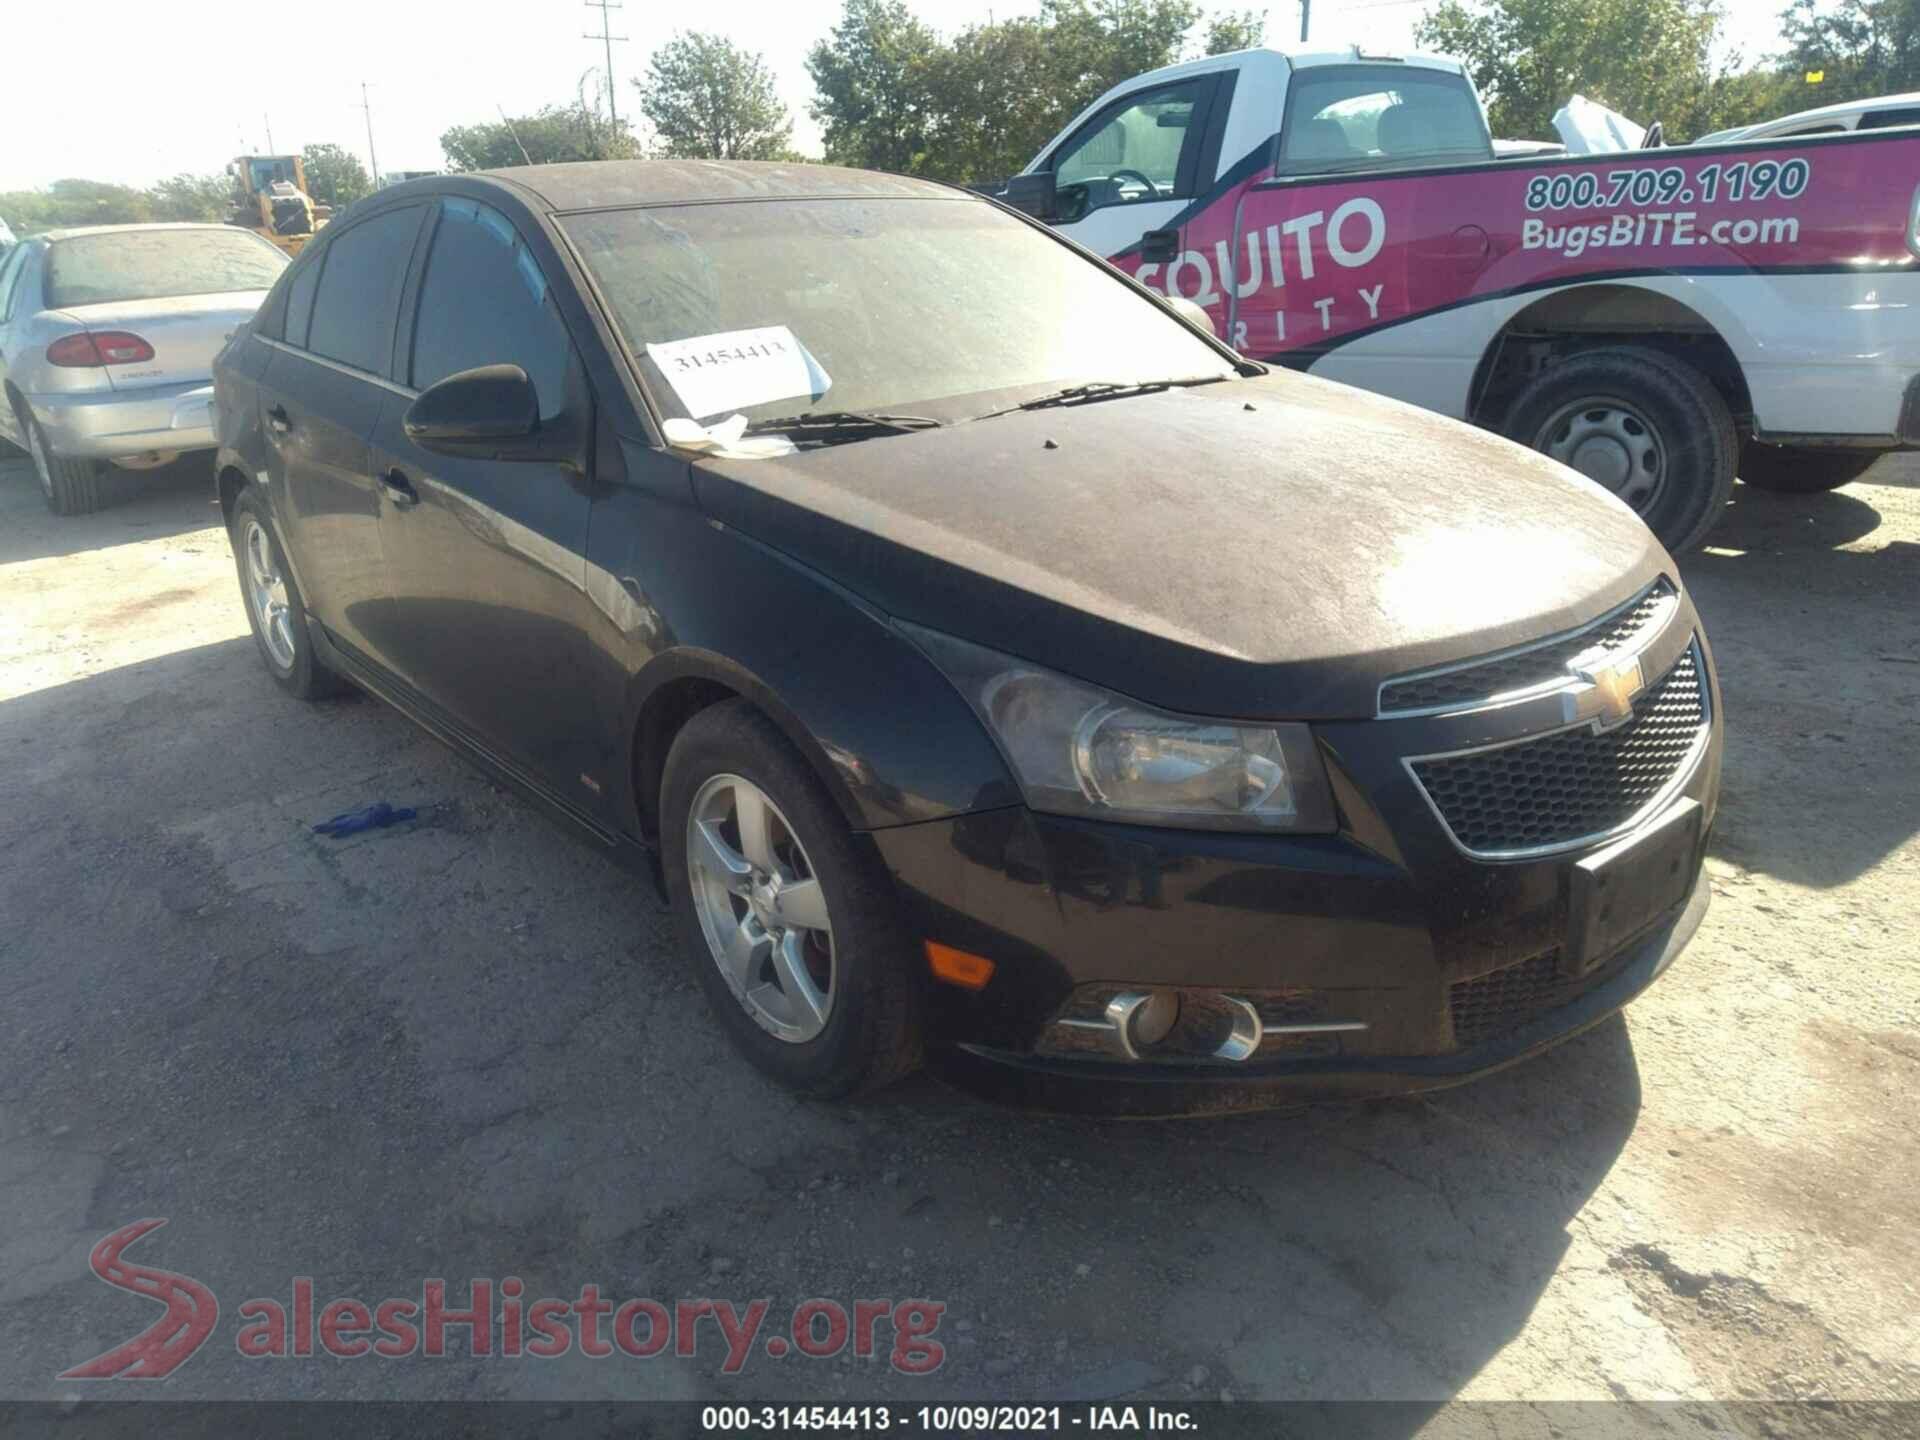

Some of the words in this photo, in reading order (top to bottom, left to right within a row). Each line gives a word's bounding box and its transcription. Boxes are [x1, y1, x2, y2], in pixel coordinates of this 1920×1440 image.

[1525, 158, 1809, 211] 800.709.1190
[1522, 212, 1799, 257] BugsBITE.com
[674, 342, 786, 372] 31454413
